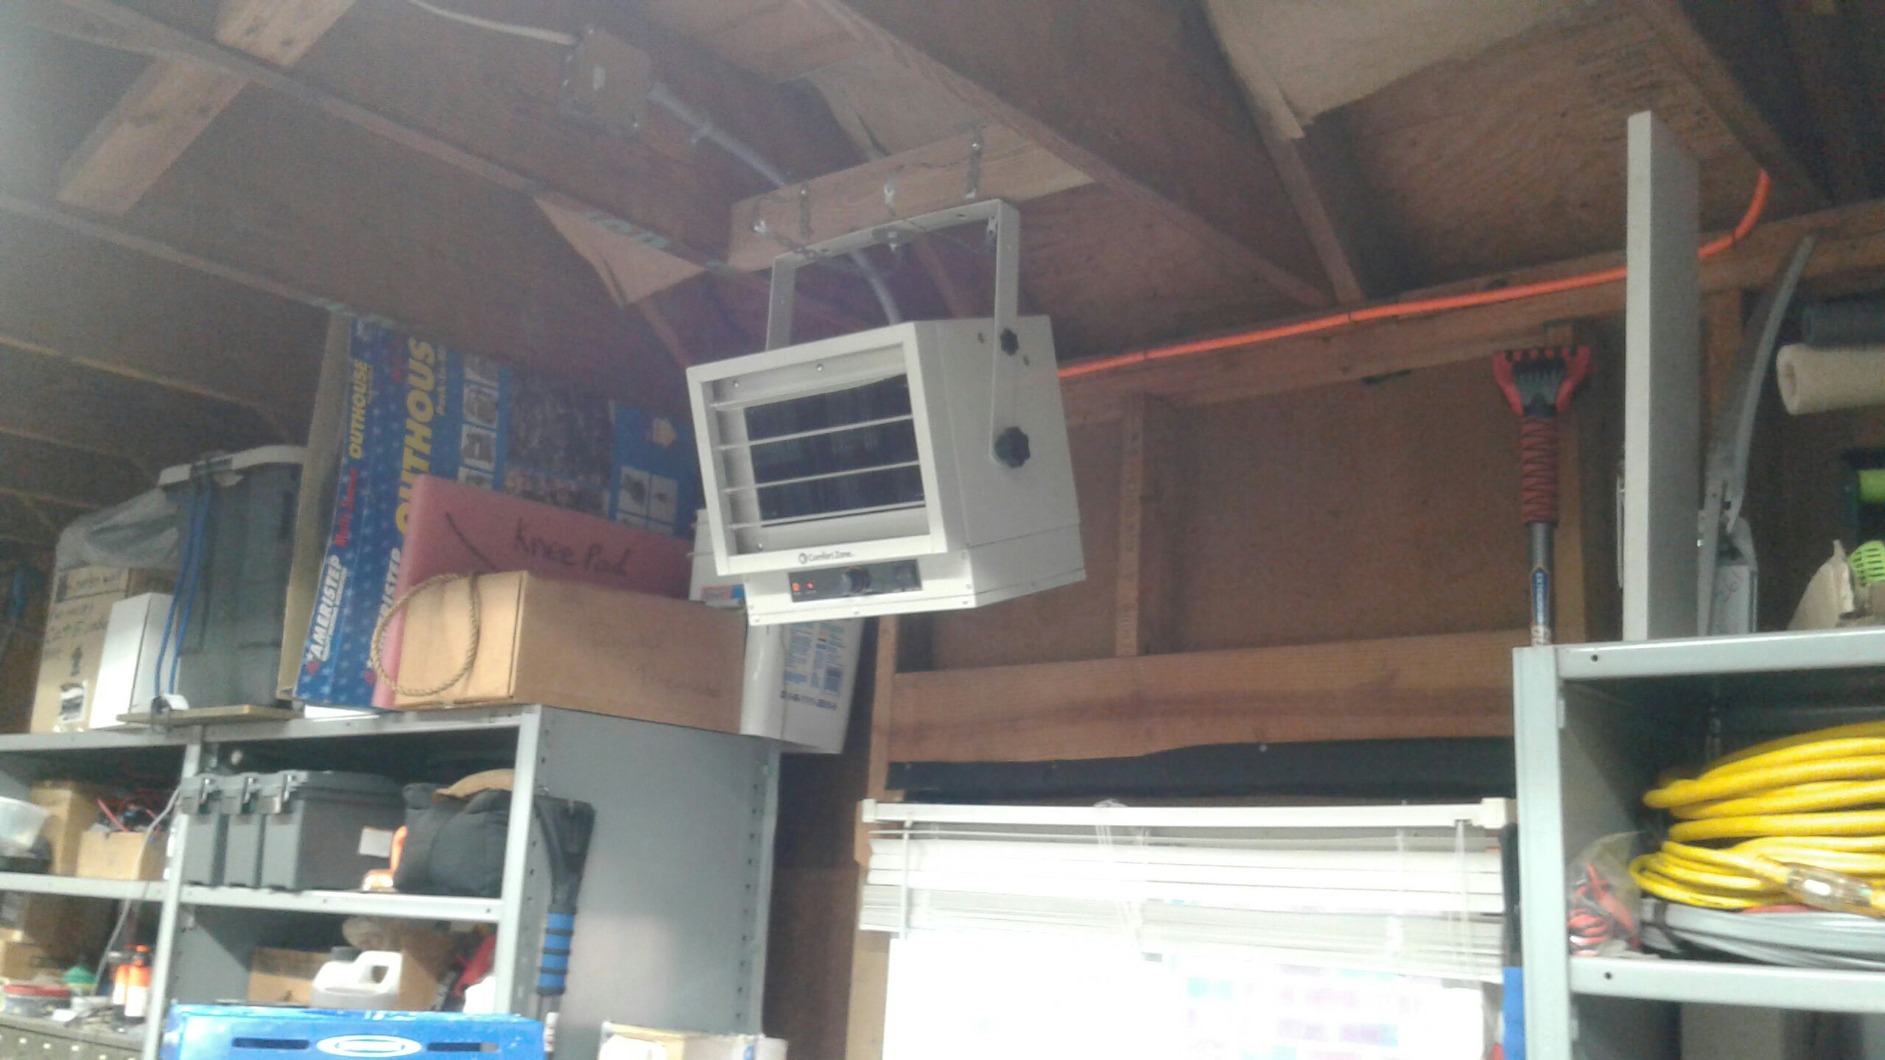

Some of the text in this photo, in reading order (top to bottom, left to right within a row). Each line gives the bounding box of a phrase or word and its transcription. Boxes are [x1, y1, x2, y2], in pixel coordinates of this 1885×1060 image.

[349, 360, 370, 459] OUTHOUSE
[514, 517, 632, 576] Knee Pad
[809, 551, 834, 562] Comfort
[310, 555, 342, 659] AMERISTEP
[379, 548, 402, 650] RISTEP
